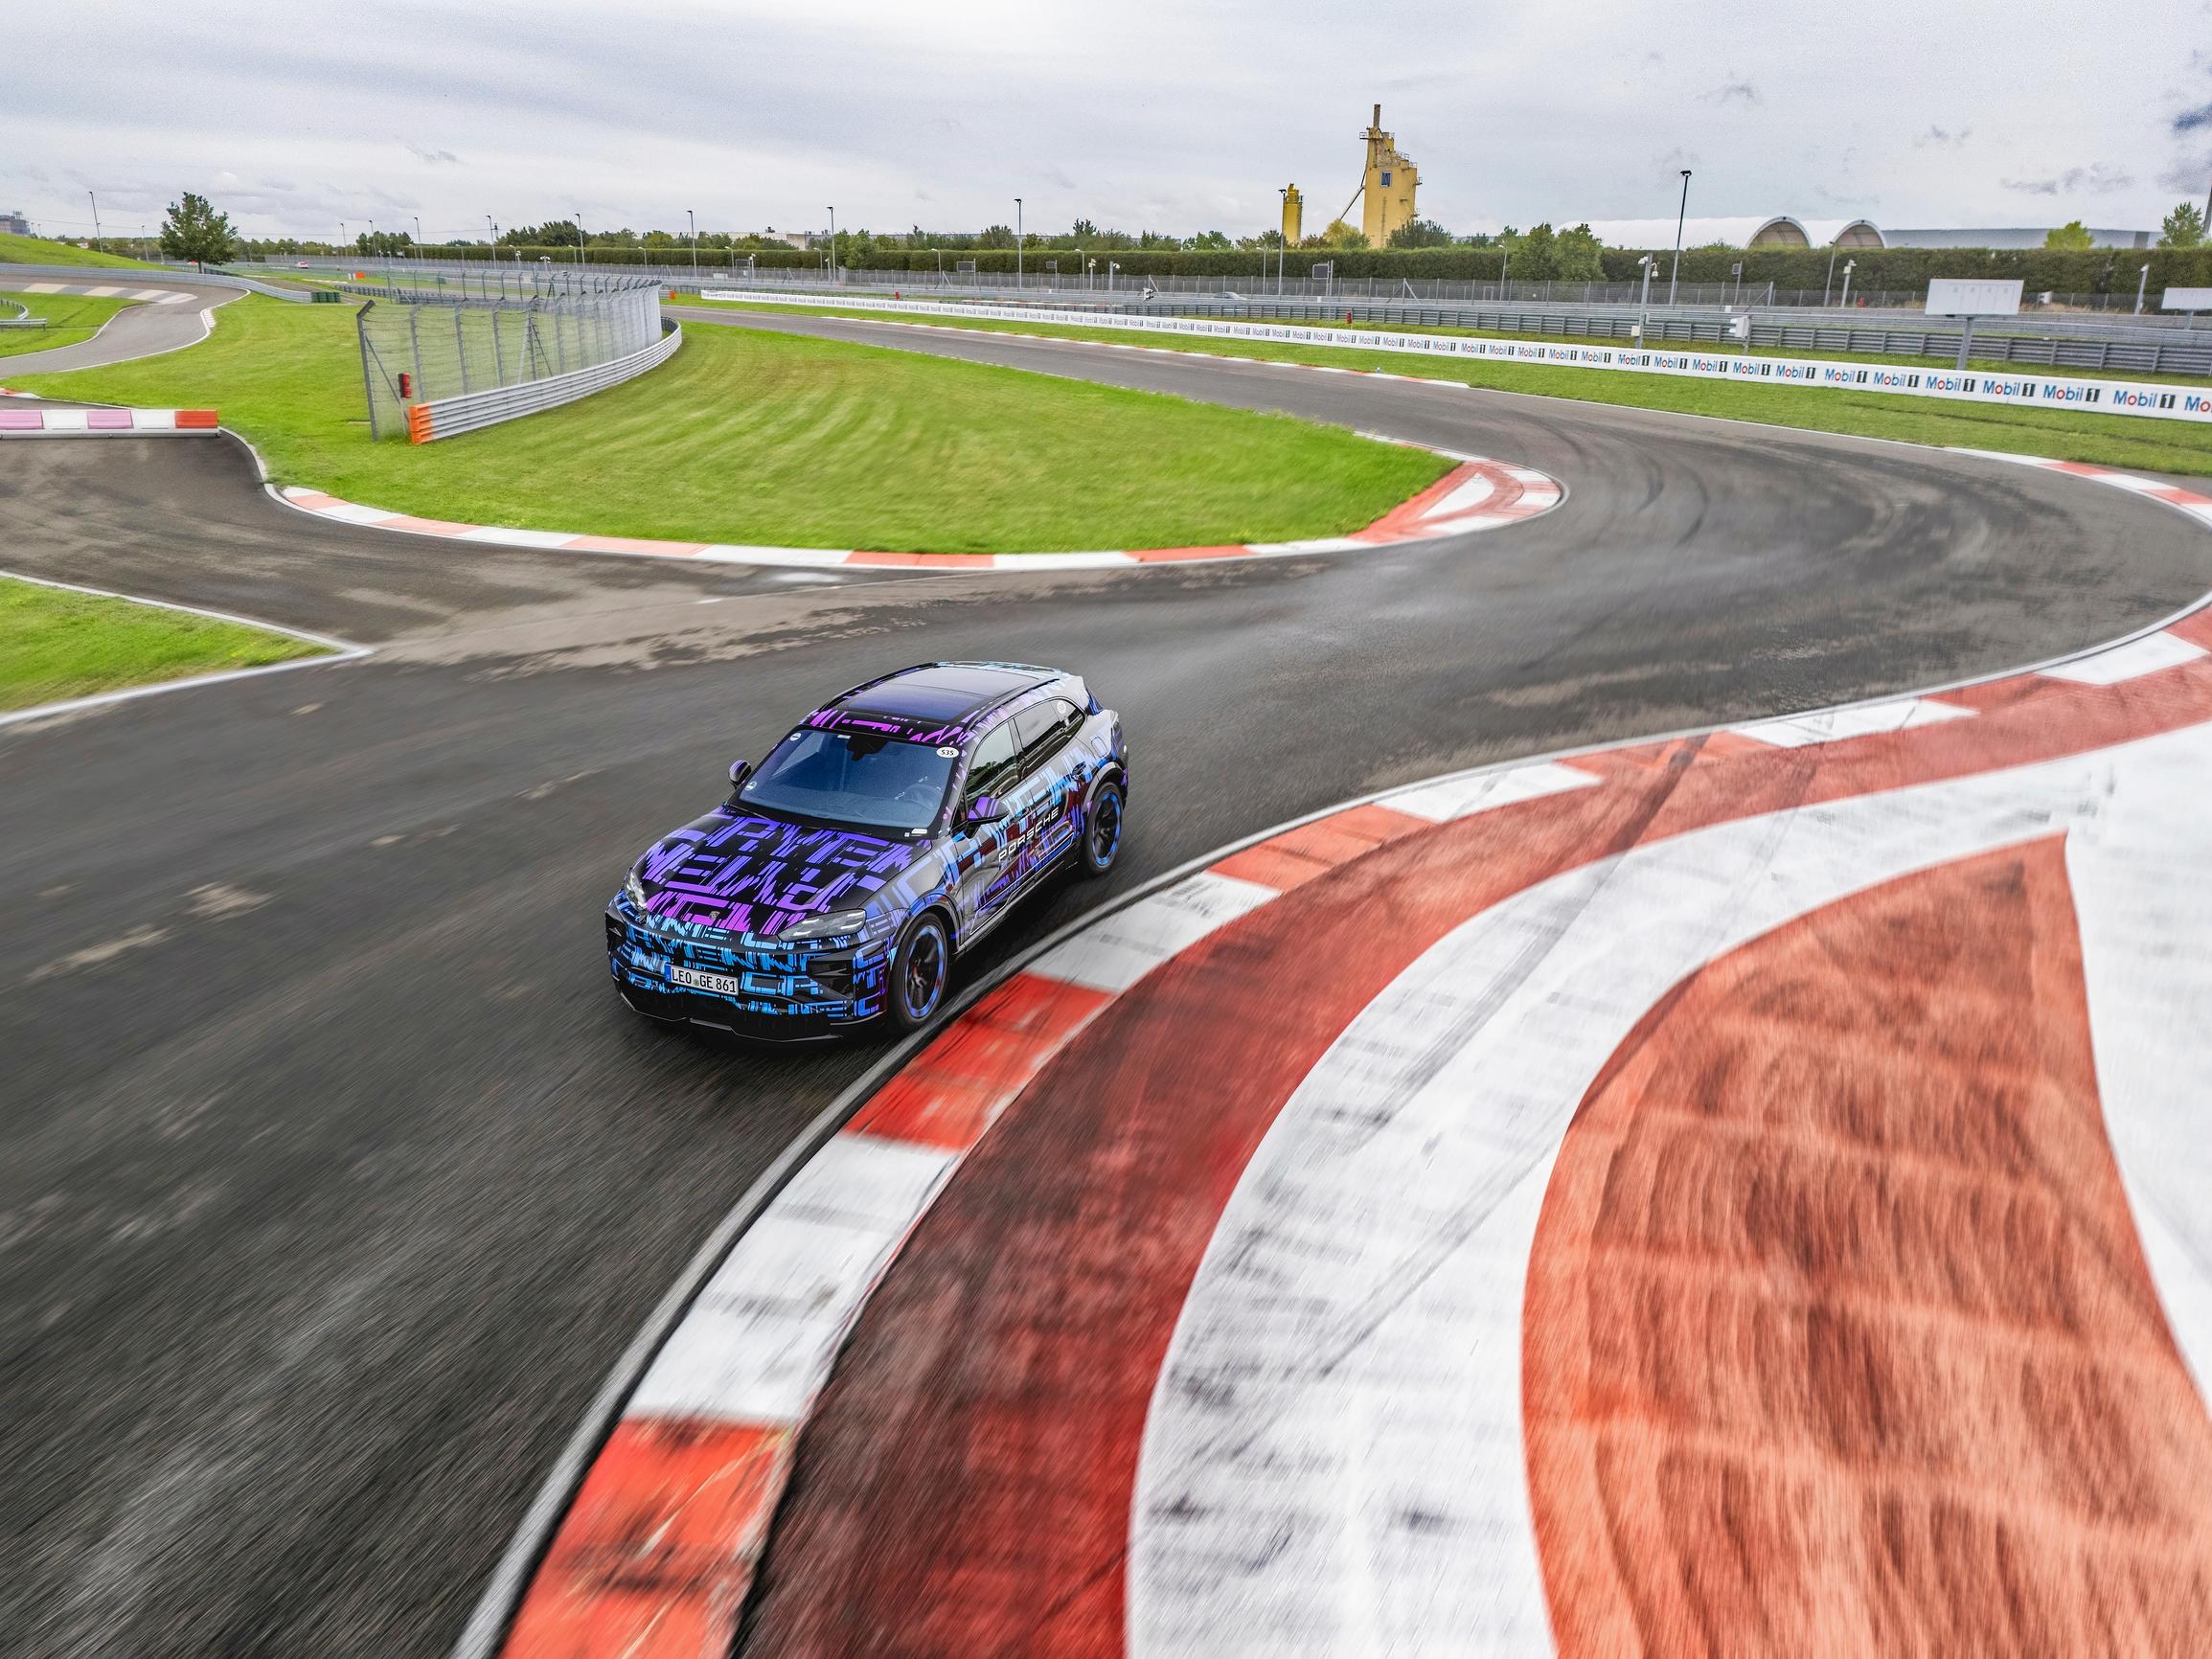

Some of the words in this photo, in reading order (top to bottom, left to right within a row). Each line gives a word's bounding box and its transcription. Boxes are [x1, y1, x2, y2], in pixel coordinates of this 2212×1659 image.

[1337, 334, 1350, 343] Mobil
[1359, 335, 1374, 345] Mobil
[1383, 337, 1398, 346] Mobil
[1408, 339, 1423, 349] Mobil
[1434, 341, 1449, 351] Mobil
[1462, 343, 1478, 353] Mobil
[1489, 345, 1507, 355] Mobil
[1518, 347, 1537, 357] Mobil
[1549, 349, 1569, 360] Mobil
[1582, 351, 1602, 362] Mobil
[1618, 354, 1640, 365] Mobil
[1654, 356, 1678, 368] Mobil
[1692, 359, 1718, 372] Mobil
[1733, 362, 1759, 375] Mobil
[1776, 365, 1804, 378] Mobil
[1825, 368, 1855, 382] Mobil
[1874, 372, 1906, 386] Mobil
[1926, 376, 1961, 391] Mobil
[1983, 380, 2020, 396] Mobil
[2043, 384, 2084, 401] Mobil
[2113, 390, 2157, 407] Mobil
[999, 807, 1059, 862] PORSCHE
[672, 969, 691, 984] LEO
[700, 975, 713, 989] GE
[716, 978, 736, 993] 861
